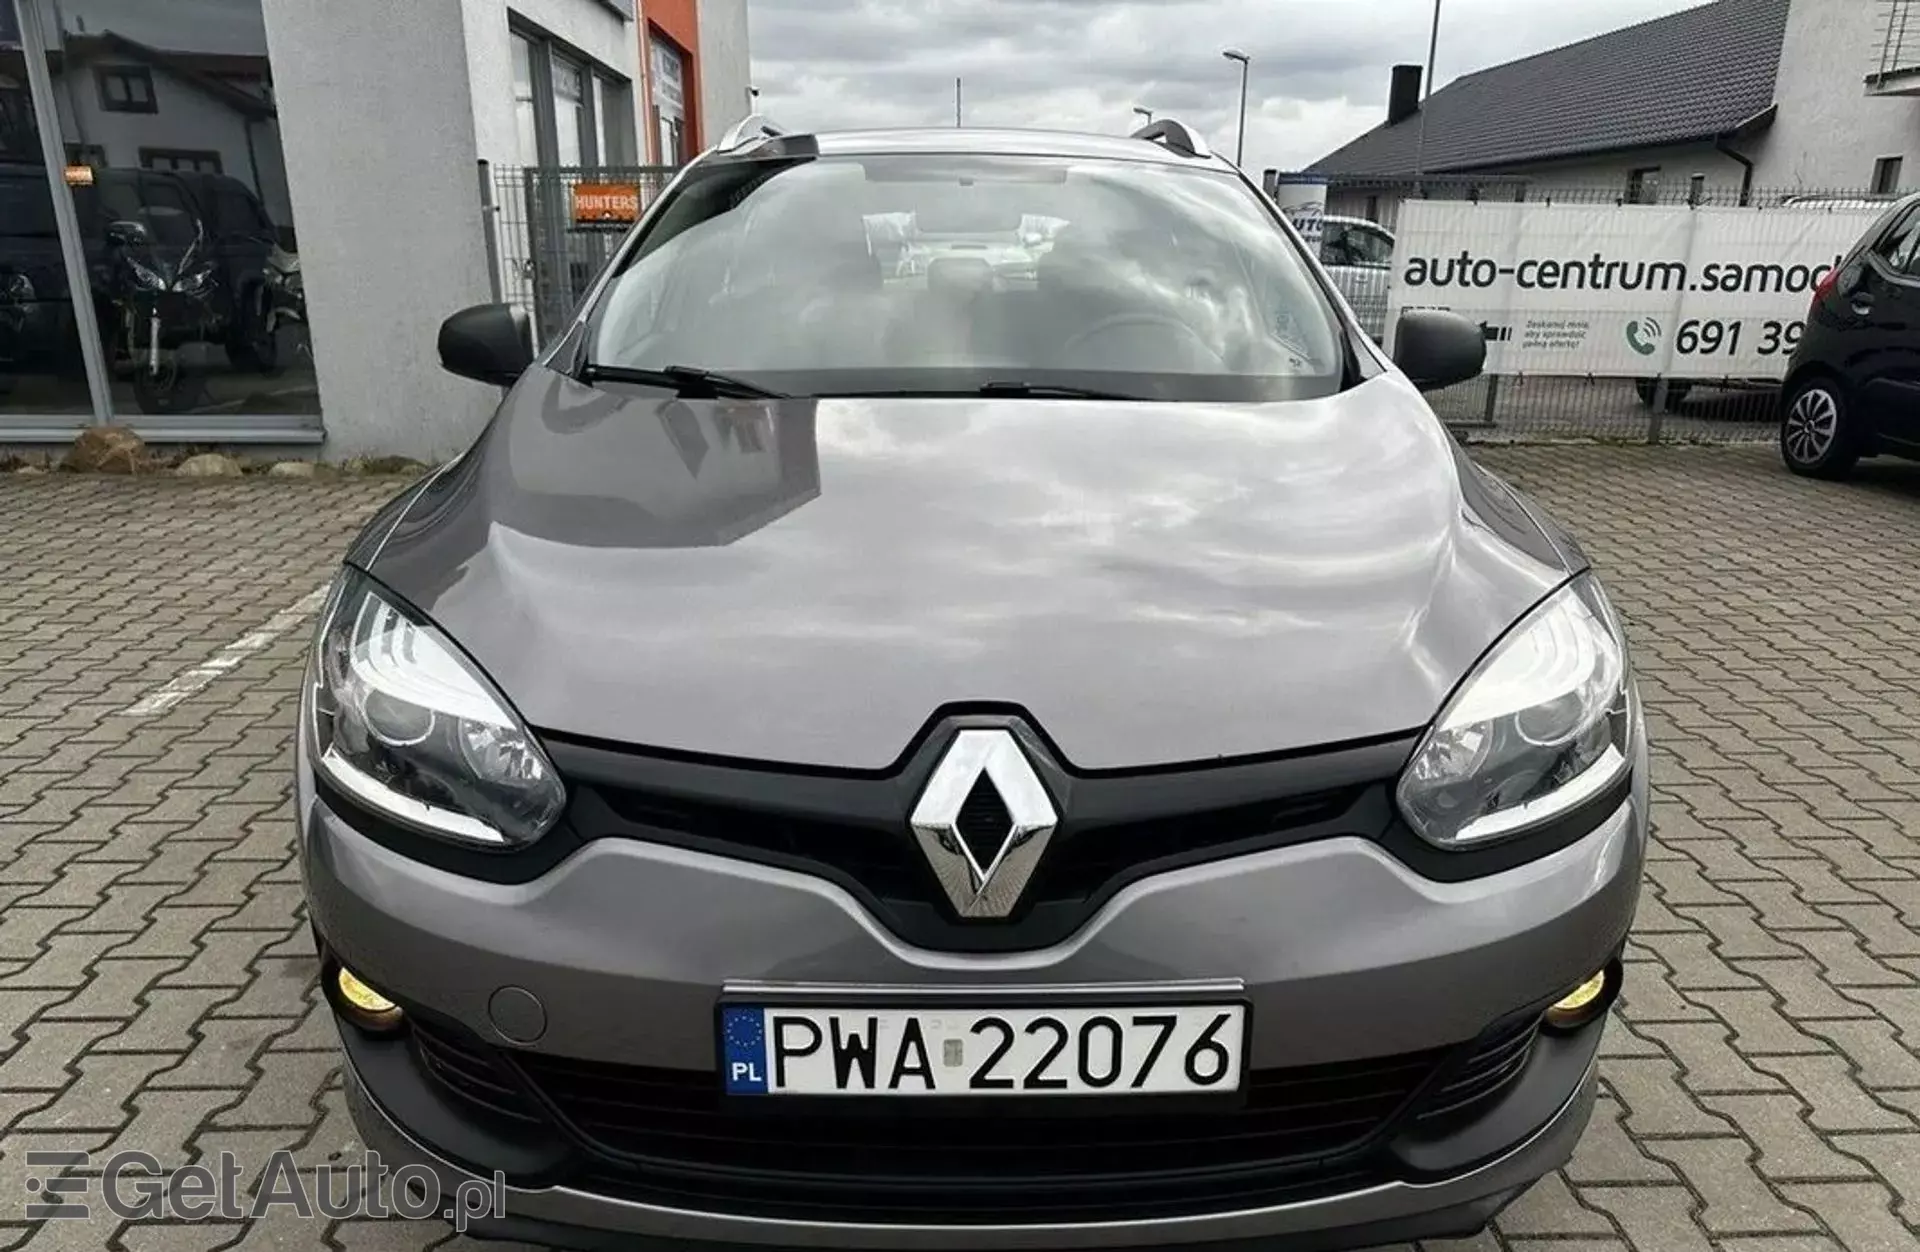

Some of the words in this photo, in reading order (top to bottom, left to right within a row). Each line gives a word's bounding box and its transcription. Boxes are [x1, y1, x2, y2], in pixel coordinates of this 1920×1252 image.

[576, 195, 638, 210] HUNTERS
[1404, 250, 1842, 293] auto-centrum.samoc
[1676, 320, 1741, 356] 691
[772, 1015, 936, 1090] PWA
[968, 1013, 1233, 1090] 22076
[732, 1061, 762, 1082] PL
